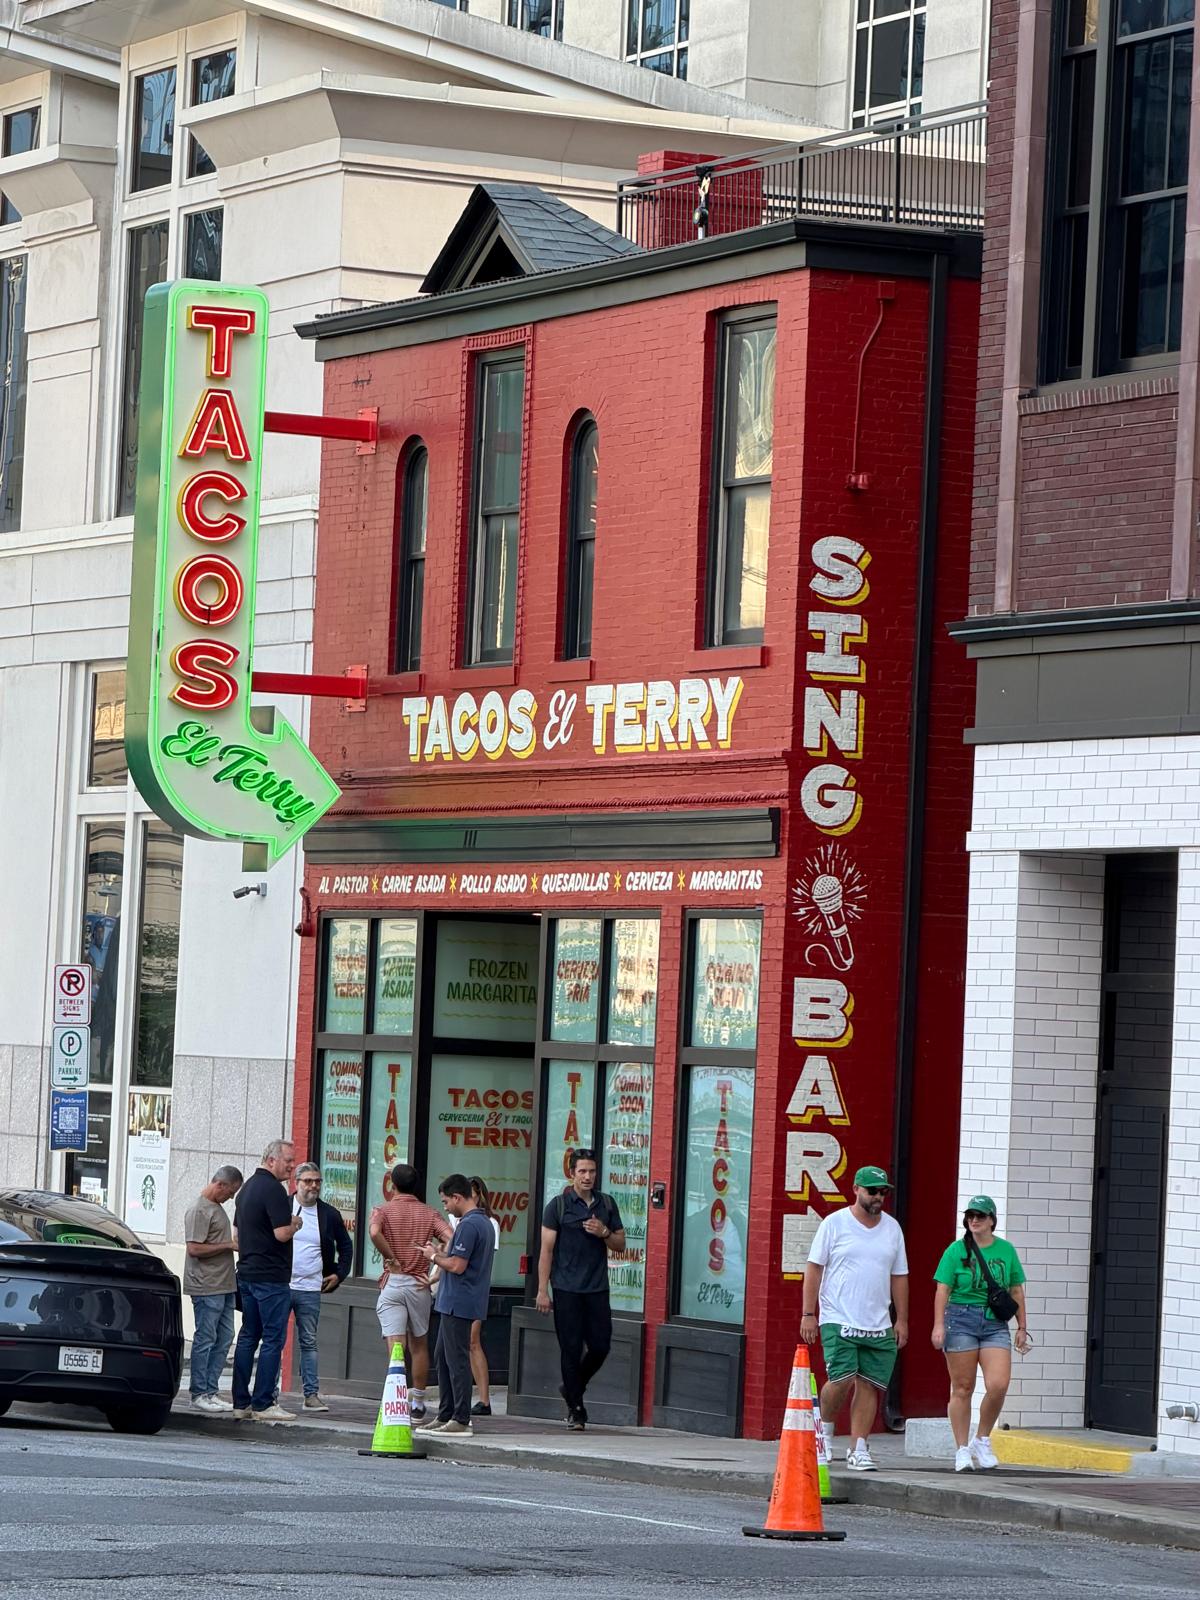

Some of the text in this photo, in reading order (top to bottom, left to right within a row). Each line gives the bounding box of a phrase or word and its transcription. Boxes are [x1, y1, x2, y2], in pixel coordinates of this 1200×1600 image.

[168, 304, 256, 711] TACOS
[801, 535, 871, 836] SING
[402, 676, 744, 762] TACOS El TERRY
[160, 719, 316, 828] El Terry
[318, 869, 763, 894] AL PASTOR CARNE ASADA POLLO ASADO QUESADILLAS CERVEZA MARGARITAS
[468, 958, 528, 980] FROZEN
[382, 980, 415, 998] ASADA
[58, 1067, 82, 1075] PARKING
[65, 1058, 76, 1066] PAY
[330, 1061, 361, 1077] COMING
[447, 1088, 534, 1110] TACOS
[785, 977, 855, 1203] BAR
[619, 1095, 644, 1113] SOON
[327, 1114, 335, 1127] AL
[438, 1112, 485, 1123] CERVECERIA
[511, 1115, 534, 1124] TAQU
[485, 1111, 503, 1127] El
[446, 1127, 533, 1148] TERRY
[610, 1132, 619, 1146] AL
[326, 1150, 341, 1162] POLLO
[609, 1172, 627, 1184] POLLO
[708, 1079, 733, 1277] TACOS
[396, 1384, 407, 1399] NO
